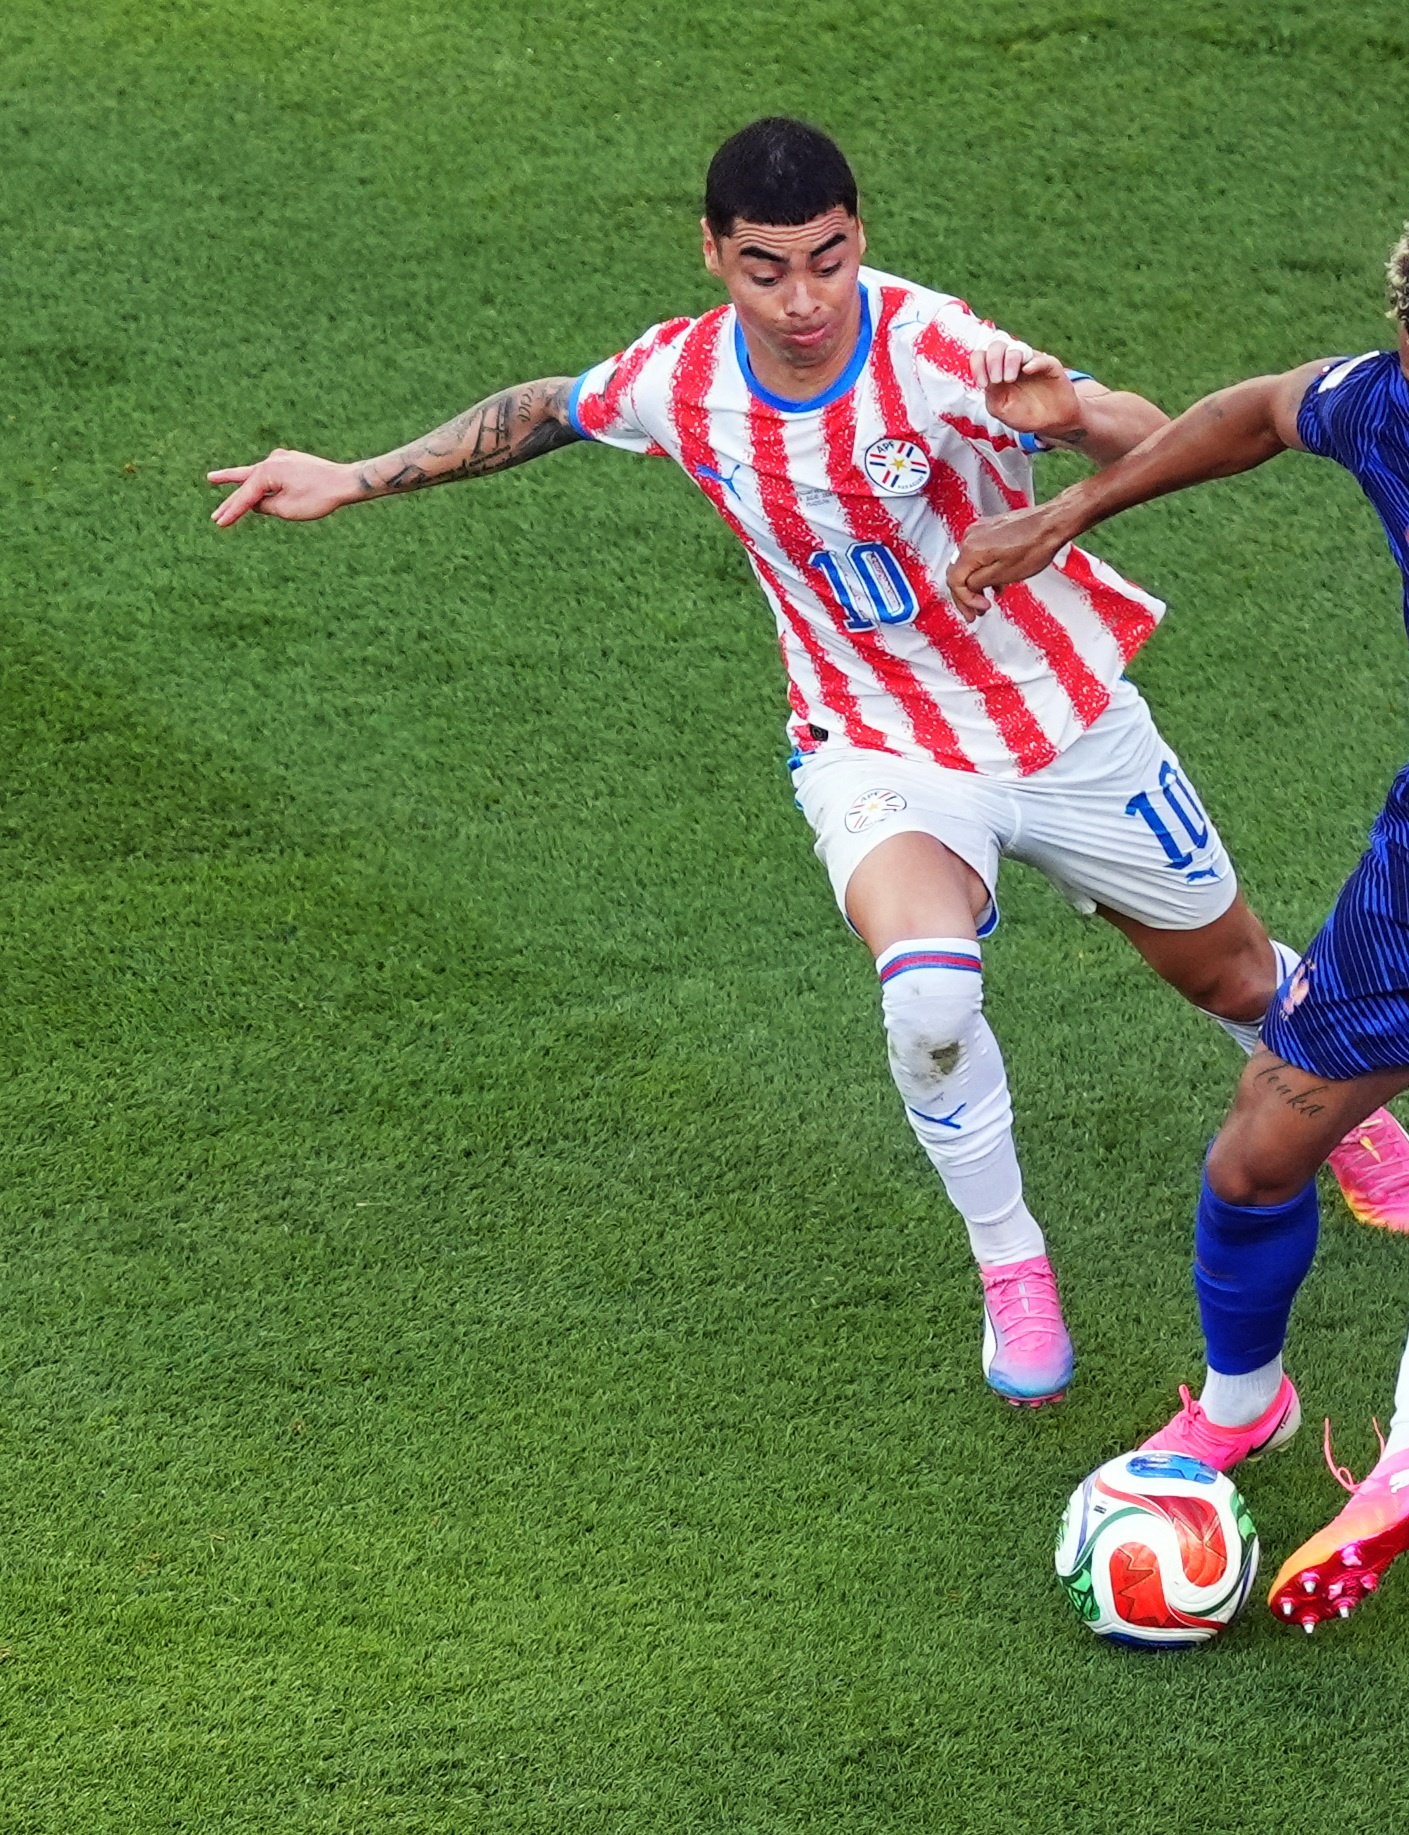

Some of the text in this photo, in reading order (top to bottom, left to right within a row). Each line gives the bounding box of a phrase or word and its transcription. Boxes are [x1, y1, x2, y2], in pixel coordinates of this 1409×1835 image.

[876, 440, 895, 453] APF
[807, 542, 920, 632] 10
[1125, 760, 1208, 870] 10
